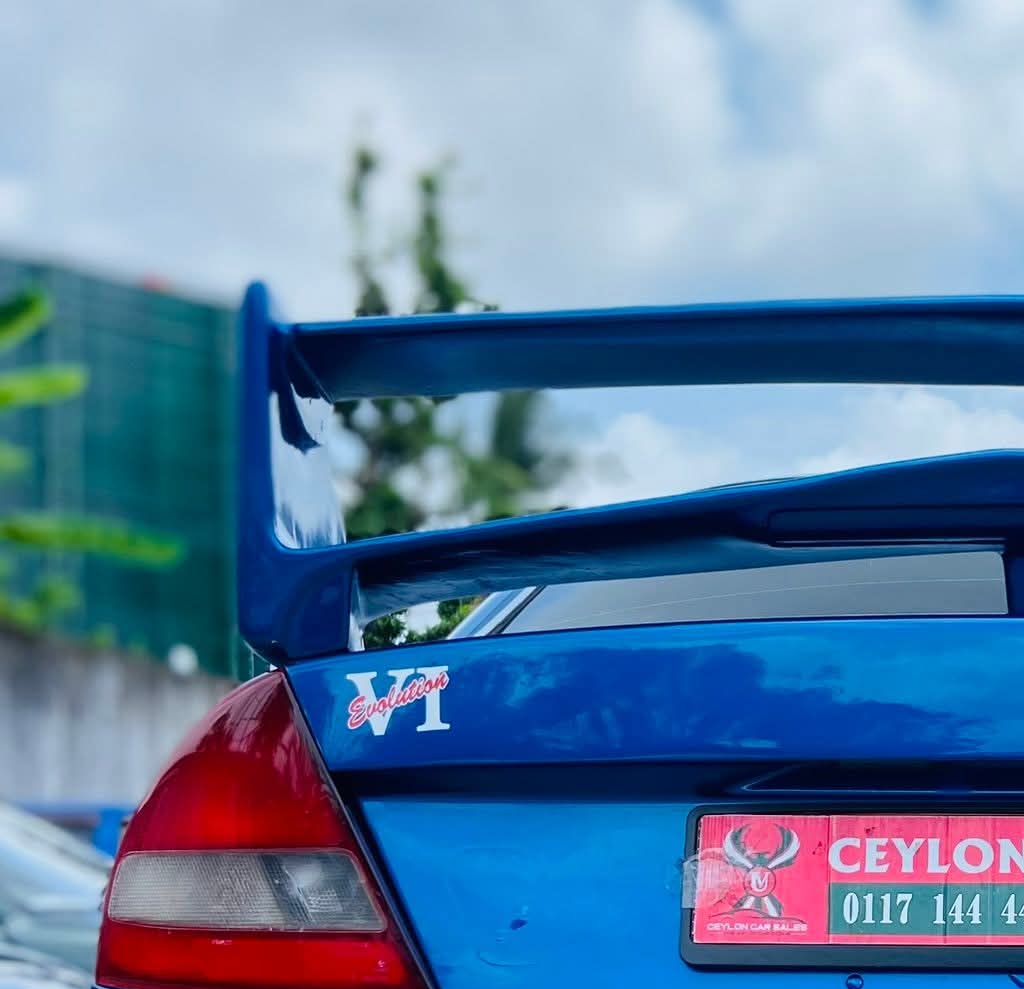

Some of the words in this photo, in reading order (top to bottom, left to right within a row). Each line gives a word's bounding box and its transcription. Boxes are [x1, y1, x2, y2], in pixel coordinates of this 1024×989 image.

[347, 671, 450, 730] Evolution
[843, 892, 913, 925] 0117
[933, 893, 982, 925] 144
[707, 922, 749, 932] CEYLON
[750, 922, 771, 932] CAR
[772, 922, 808, 932] SALES
